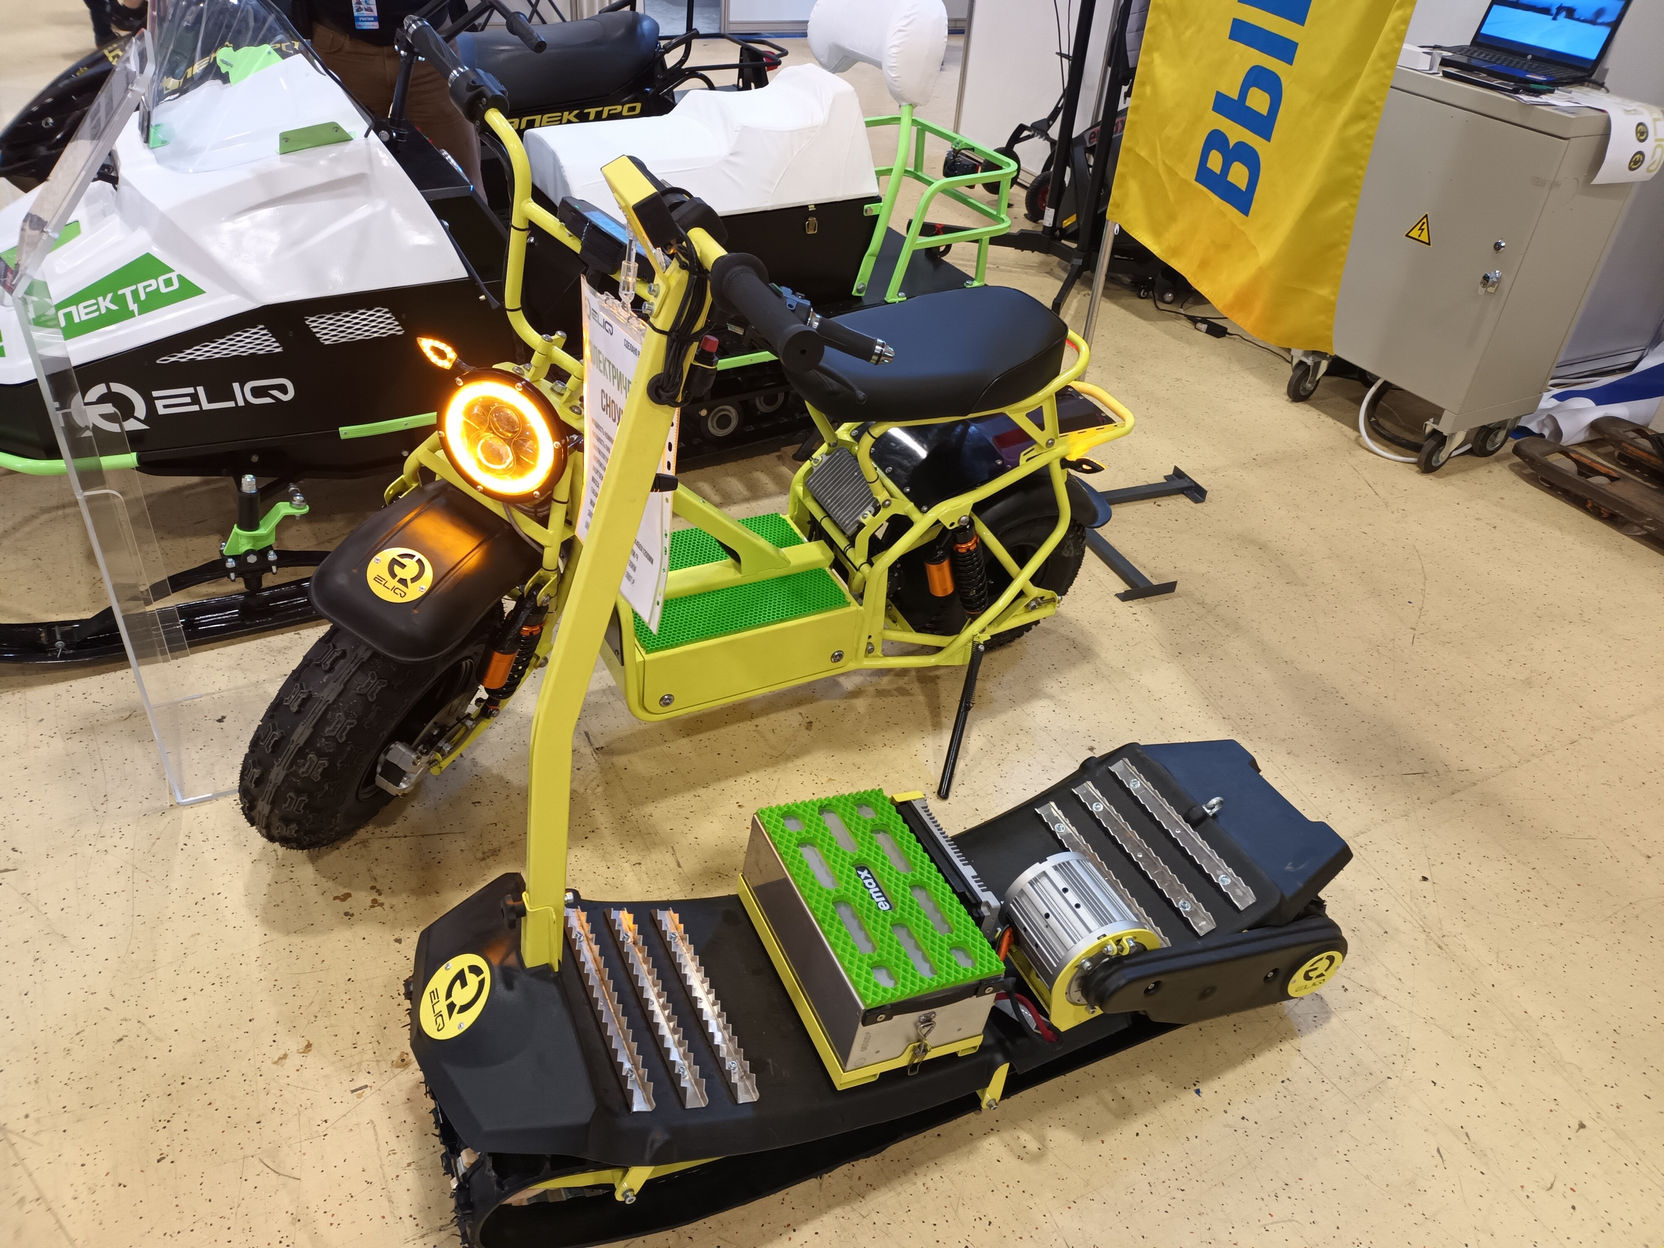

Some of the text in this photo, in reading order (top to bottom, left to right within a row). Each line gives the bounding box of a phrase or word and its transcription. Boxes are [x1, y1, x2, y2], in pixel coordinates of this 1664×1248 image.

[151, 377, 295, 415] ELIQ
[373, 574, 407, 598] ELIQ
[856, 868, 891, 911] emax
[429, 987, 446, 1032] ELIQ
